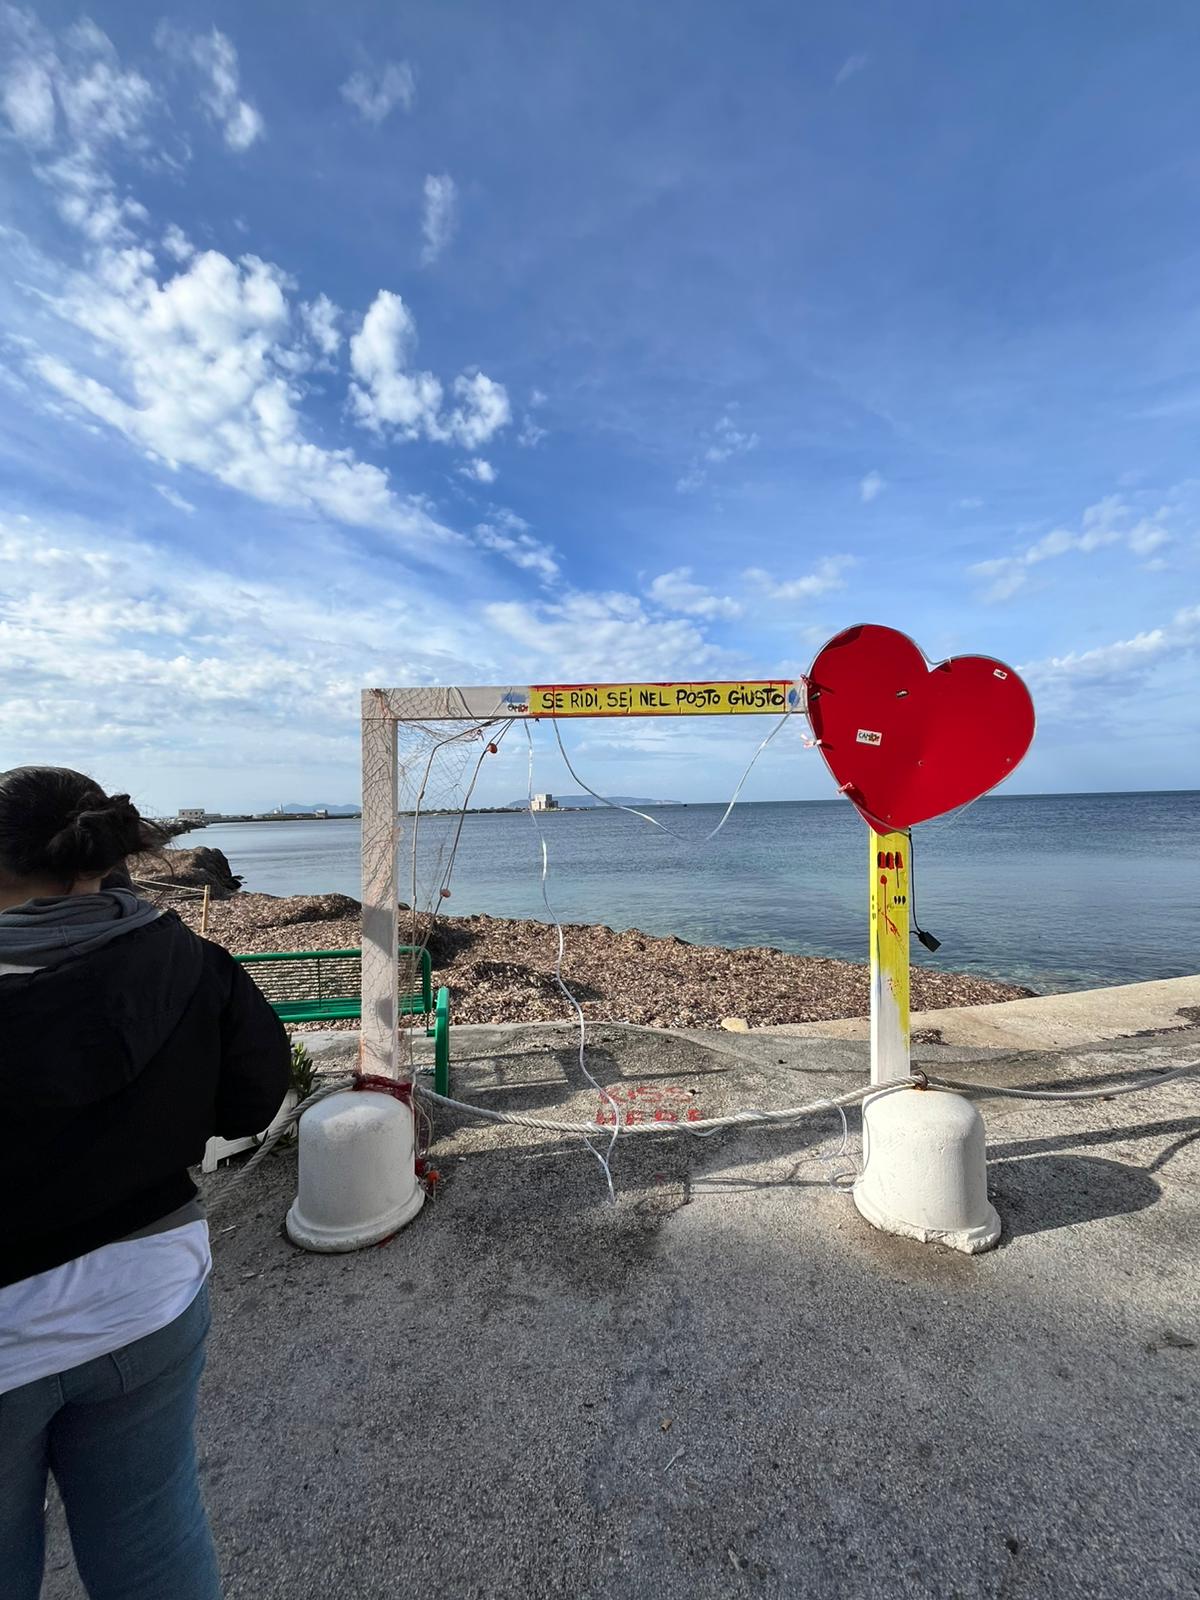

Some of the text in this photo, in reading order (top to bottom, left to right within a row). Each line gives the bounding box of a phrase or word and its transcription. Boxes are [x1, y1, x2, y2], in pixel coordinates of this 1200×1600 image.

[541, 692, 564, 709] SE
[639, 690, 670, 707] NEL
[676, 688, 721, 708] POSTO
[728, 686, 785, 708] GIUSTO
